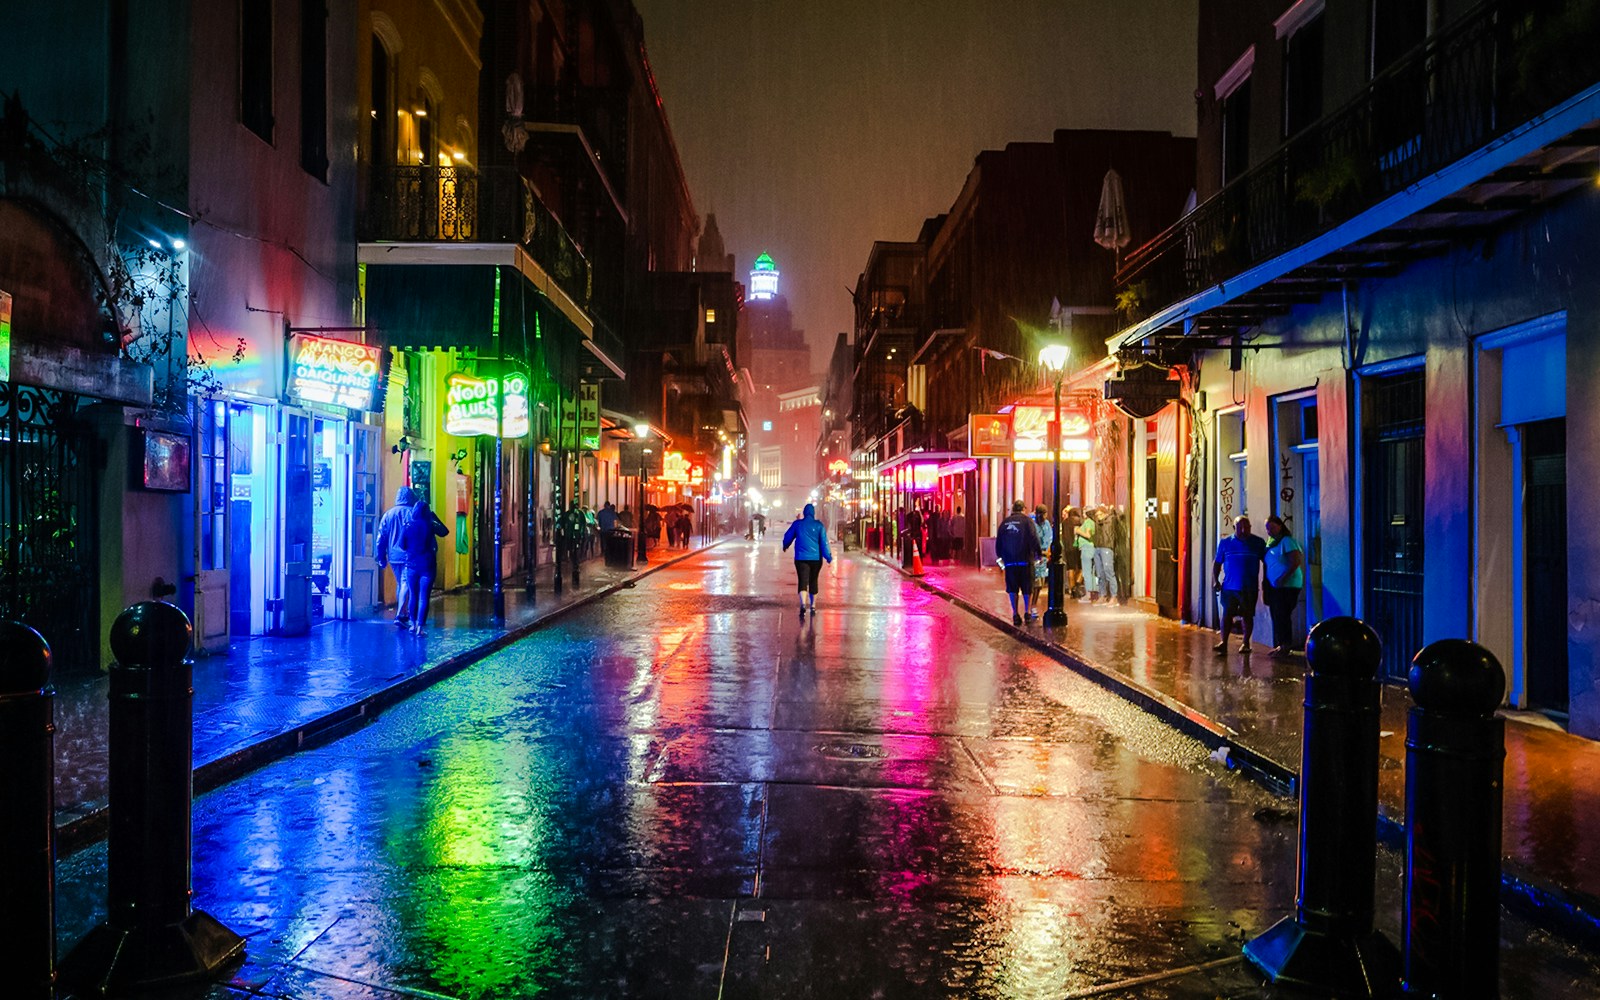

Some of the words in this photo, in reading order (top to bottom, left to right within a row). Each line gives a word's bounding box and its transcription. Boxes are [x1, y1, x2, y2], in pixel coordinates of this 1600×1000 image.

[309, 341, 366, 358] MANGO
[296, 348, 376, 376] MANGO
[296, 366, 370, 388] DAIQUIRIS
[450, 397, 497, 419] BLUES
[554, 407, 596, 421] Oais
